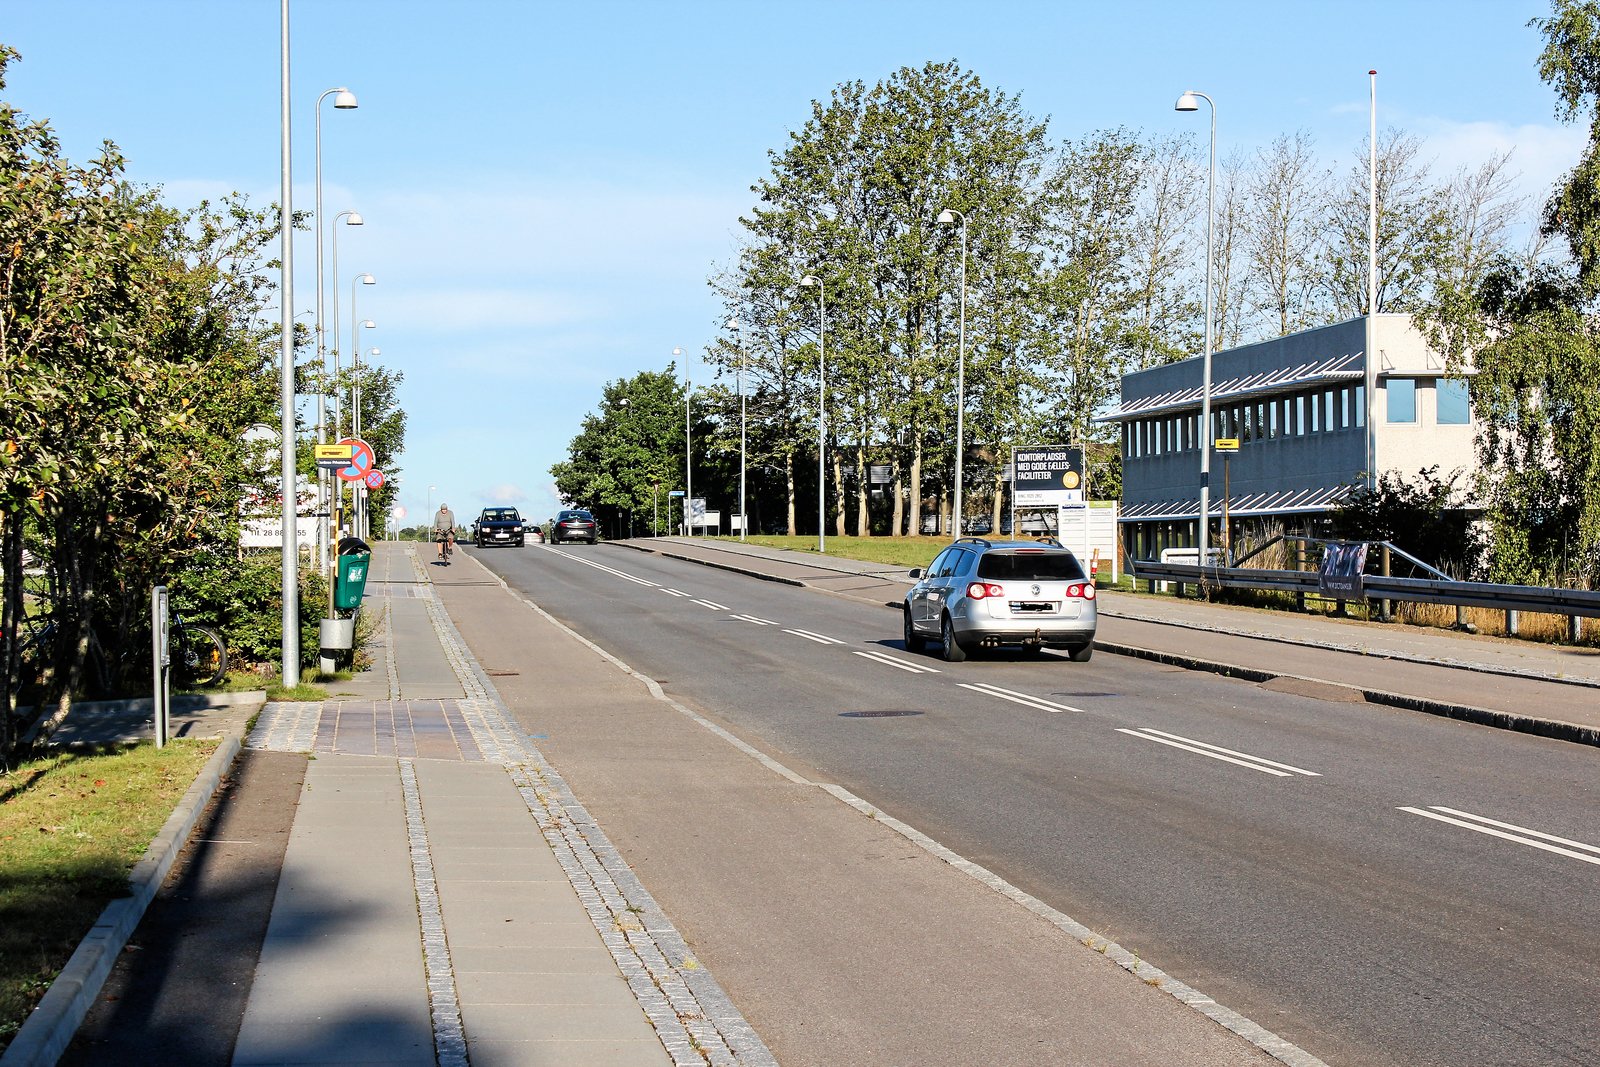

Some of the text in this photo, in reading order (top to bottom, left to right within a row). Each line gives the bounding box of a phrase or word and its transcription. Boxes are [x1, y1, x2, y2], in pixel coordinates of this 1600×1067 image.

[1018, 453, 1066, 461] KONTORPLADSER
[1031, 462, 1047, 470] GODE
[1018, 472, 1051, 480] FACILITETER
